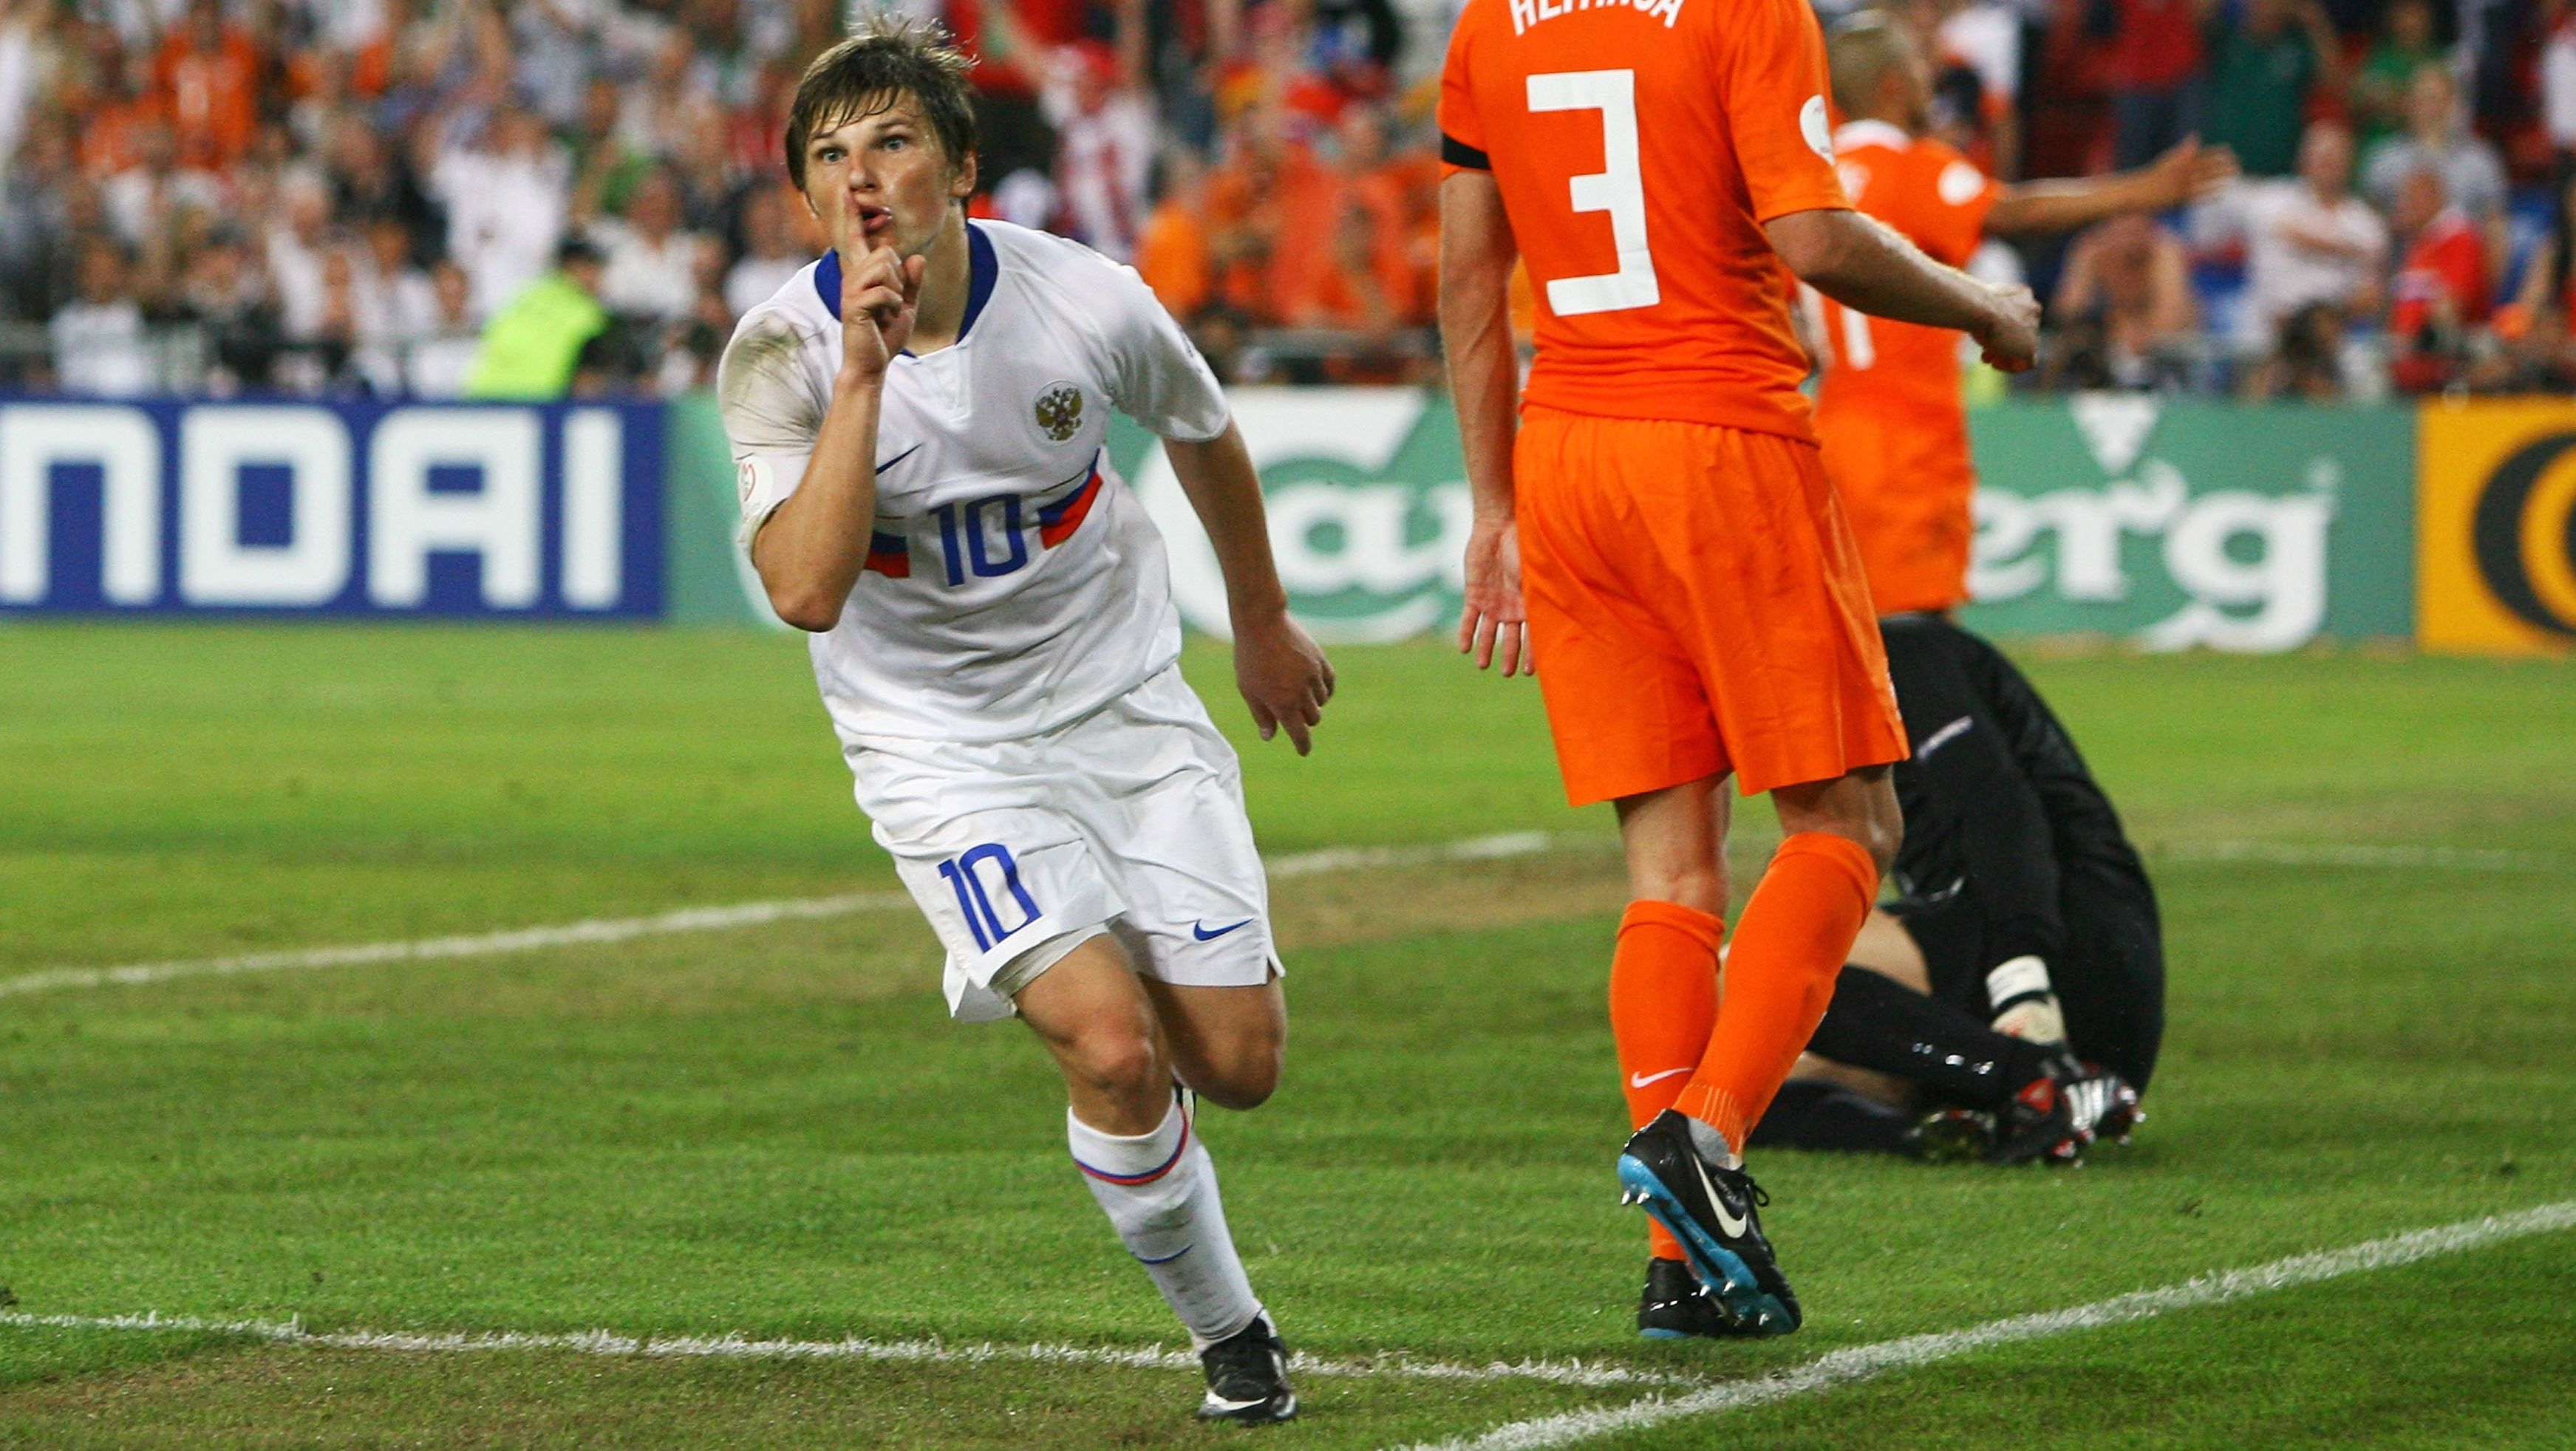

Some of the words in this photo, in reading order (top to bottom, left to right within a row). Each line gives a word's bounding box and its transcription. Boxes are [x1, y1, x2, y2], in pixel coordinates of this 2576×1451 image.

[1525, 69, 1660, 316] 3
[0, 403, 624, 608] NDAI
[927, 493, 1028, 587] 10
[937, 842, 1042, 955] 10
